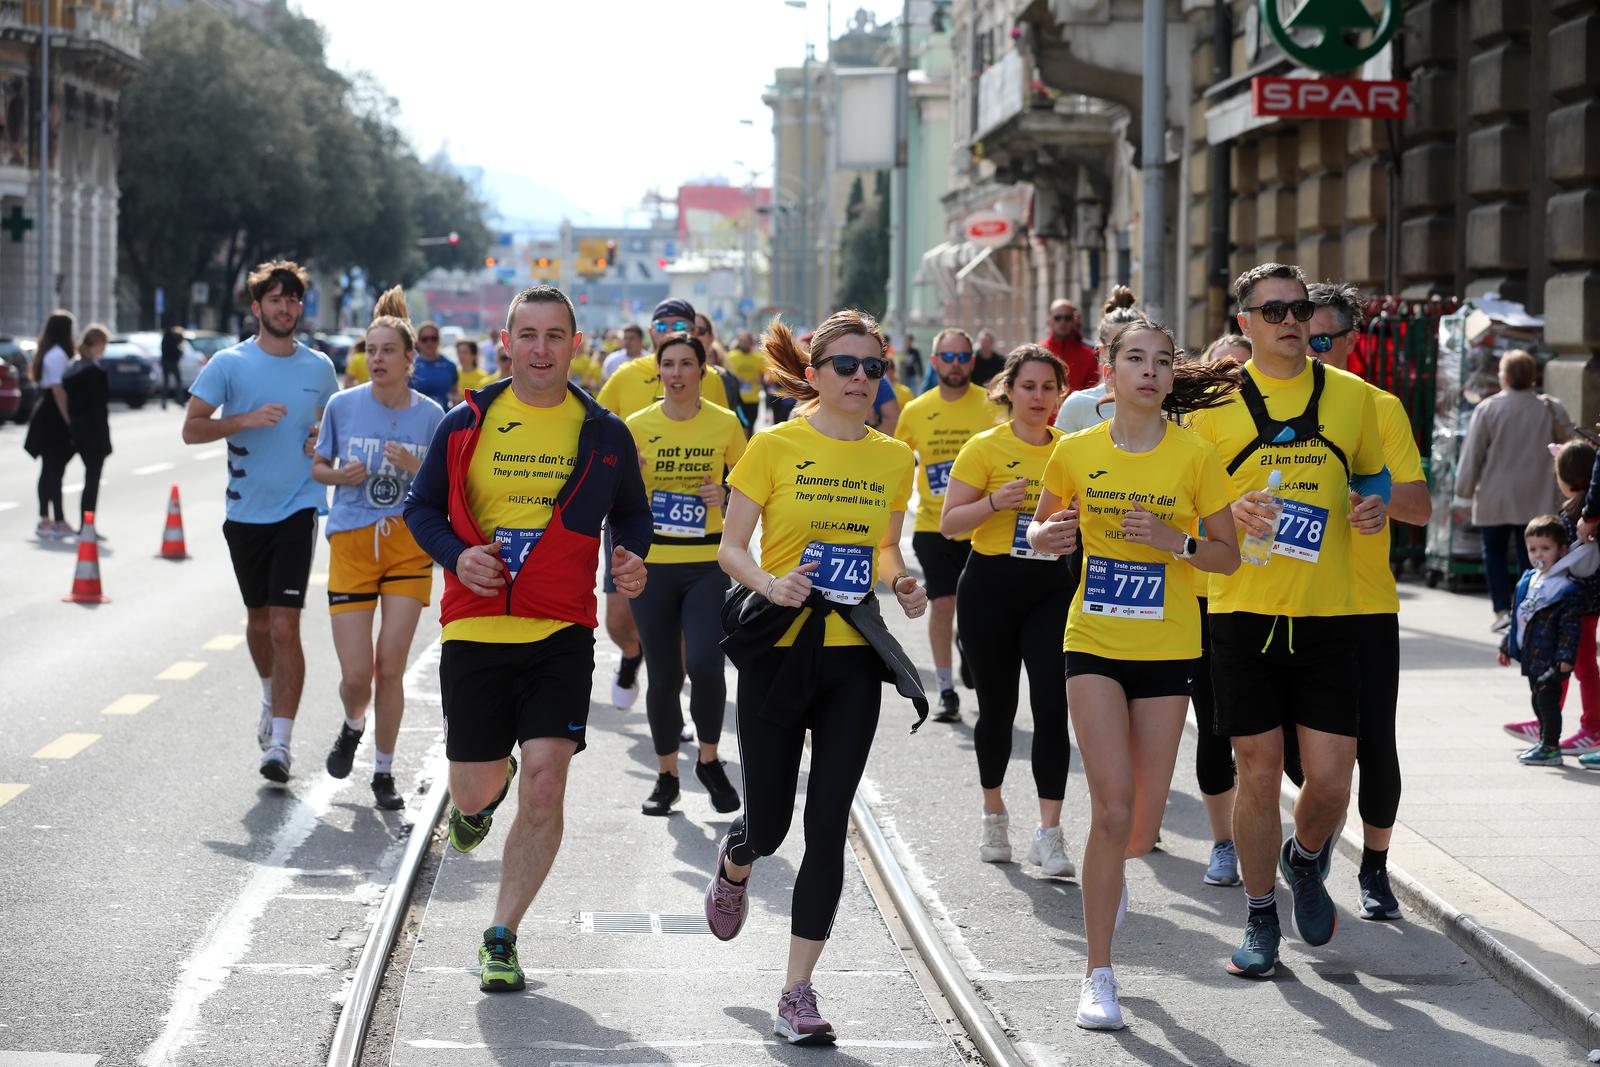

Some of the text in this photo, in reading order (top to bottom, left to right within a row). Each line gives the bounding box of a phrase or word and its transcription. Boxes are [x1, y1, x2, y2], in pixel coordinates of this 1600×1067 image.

[1264, 83, 1399, 111] SPAR
[493, 451, 536, 463] Runners
[538, 453, 564, 466] don't
[657, 446, 715, 459] not your
[655, 460, 713, 472] PB race.
[1261, 453, 1327, 466] 21 km today!
[493, 468, 569, 480] They only smell like
[795, 475, 885, 493] Runners don't die!
[1279, 482, 1319, 491] EKARUN
[508, 495, 556, 506] RIJEKARU
[795, 492, 815, 501] They
[817, 493, 834, 503] only
[836, 495, 857, 504] smell
[859, 496, 873, 506] like
[1086, 487, 1176, 507] Runners don't die!
[669, 503, 706, 523] 659
[1088, 505, 1102, 514] They
[1104, 506, 1120, 515] only
[811, 521, 869, 534] RIJEKARUN
[1280, 513, 1322, 543] 778
[805, 548, 822, 557] RUN
[829, 558, 870, 585] 743
[1090, 565, 1106, 574] RUN
[1114, 573, 1162, 600] 777
